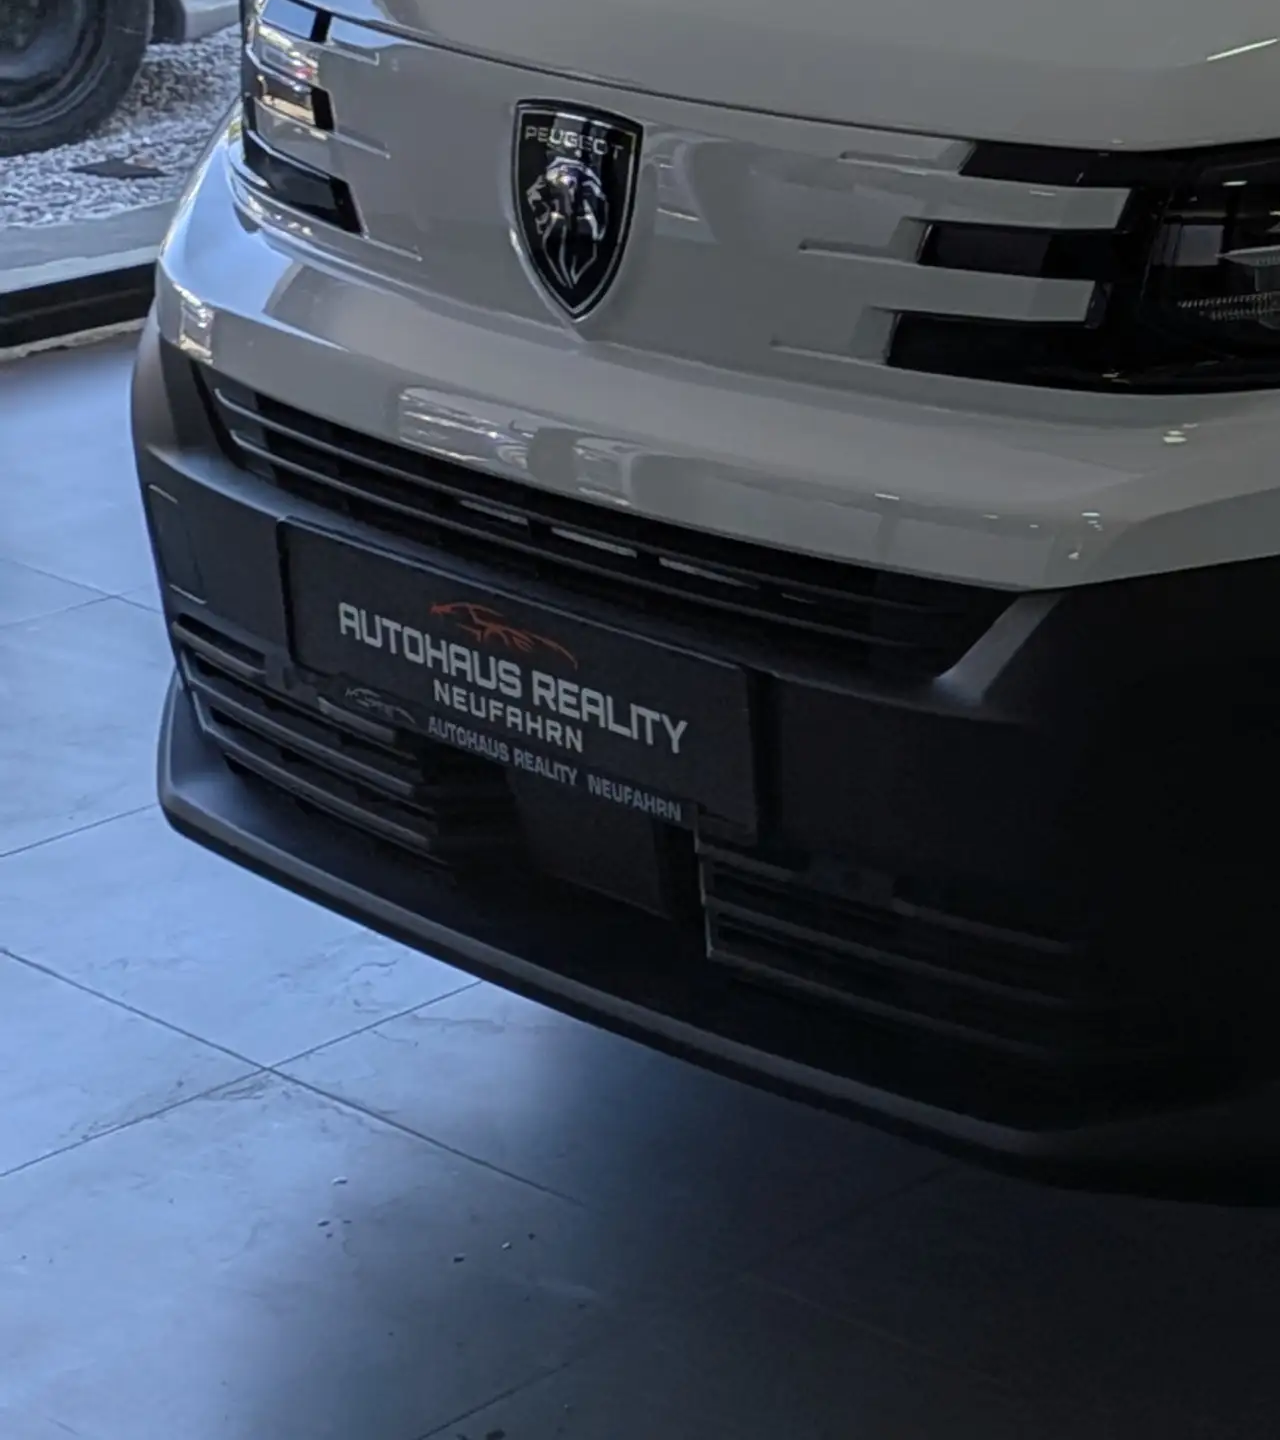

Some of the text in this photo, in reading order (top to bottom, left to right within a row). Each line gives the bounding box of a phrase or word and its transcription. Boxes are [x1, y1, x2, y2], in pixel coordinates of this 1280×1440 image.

[525, 125, 624, 160] PEUGEOT
[338, 601, 688, 755] AUTOHAUS REALITY
[433, 678, 584, 753] NEUFAHRN
[428, 716, 682, 822] AUTOHAUS REALITY NEUFAHRN
